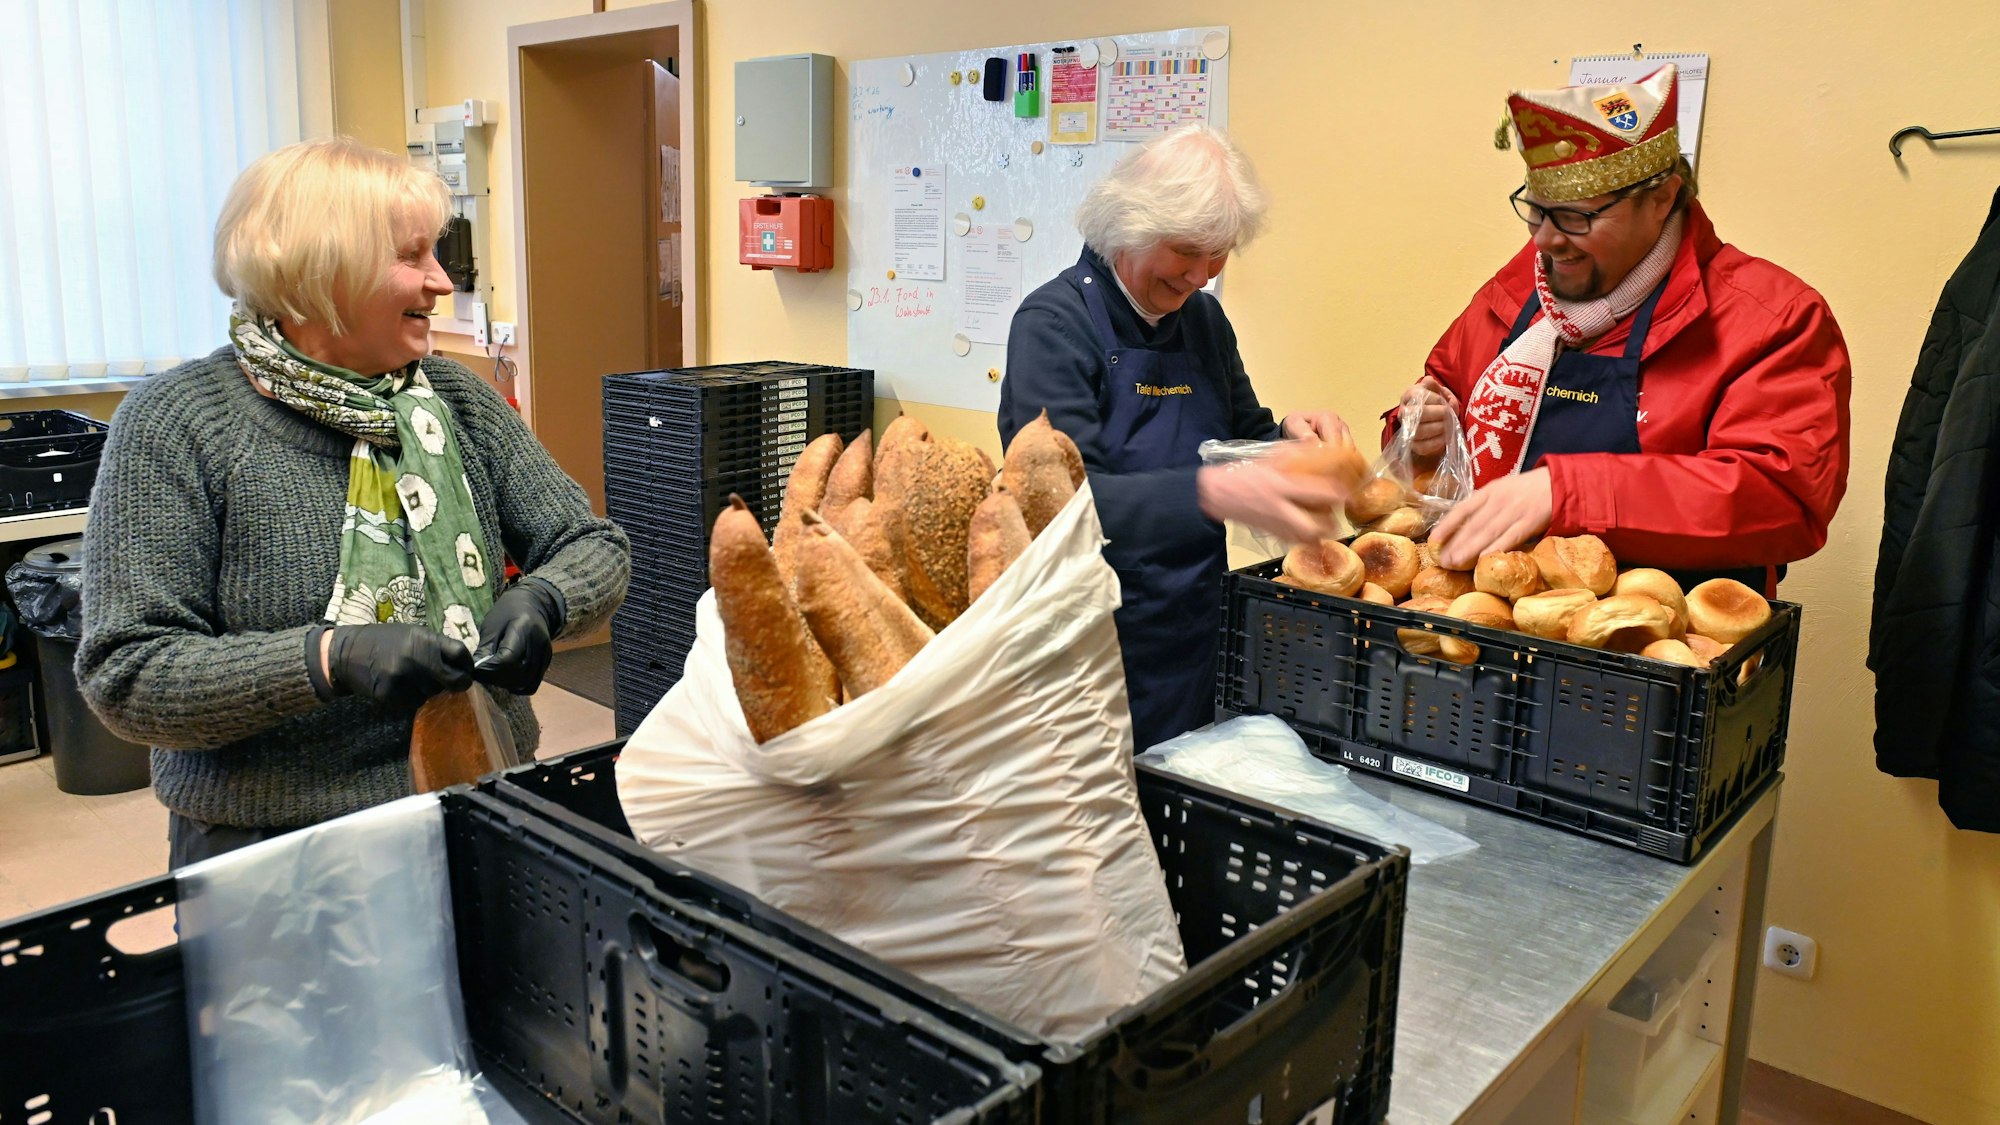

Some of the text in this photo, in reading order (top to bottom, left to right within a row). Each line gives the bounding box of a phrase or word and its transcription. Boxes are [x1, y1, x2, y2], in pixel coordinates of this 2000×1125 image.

[1579, 72, 1627, 84] Januar
[753, 222, 769, 230] ERSTE
[1343, 751, 1452, 781] LL 6420 IFCO
